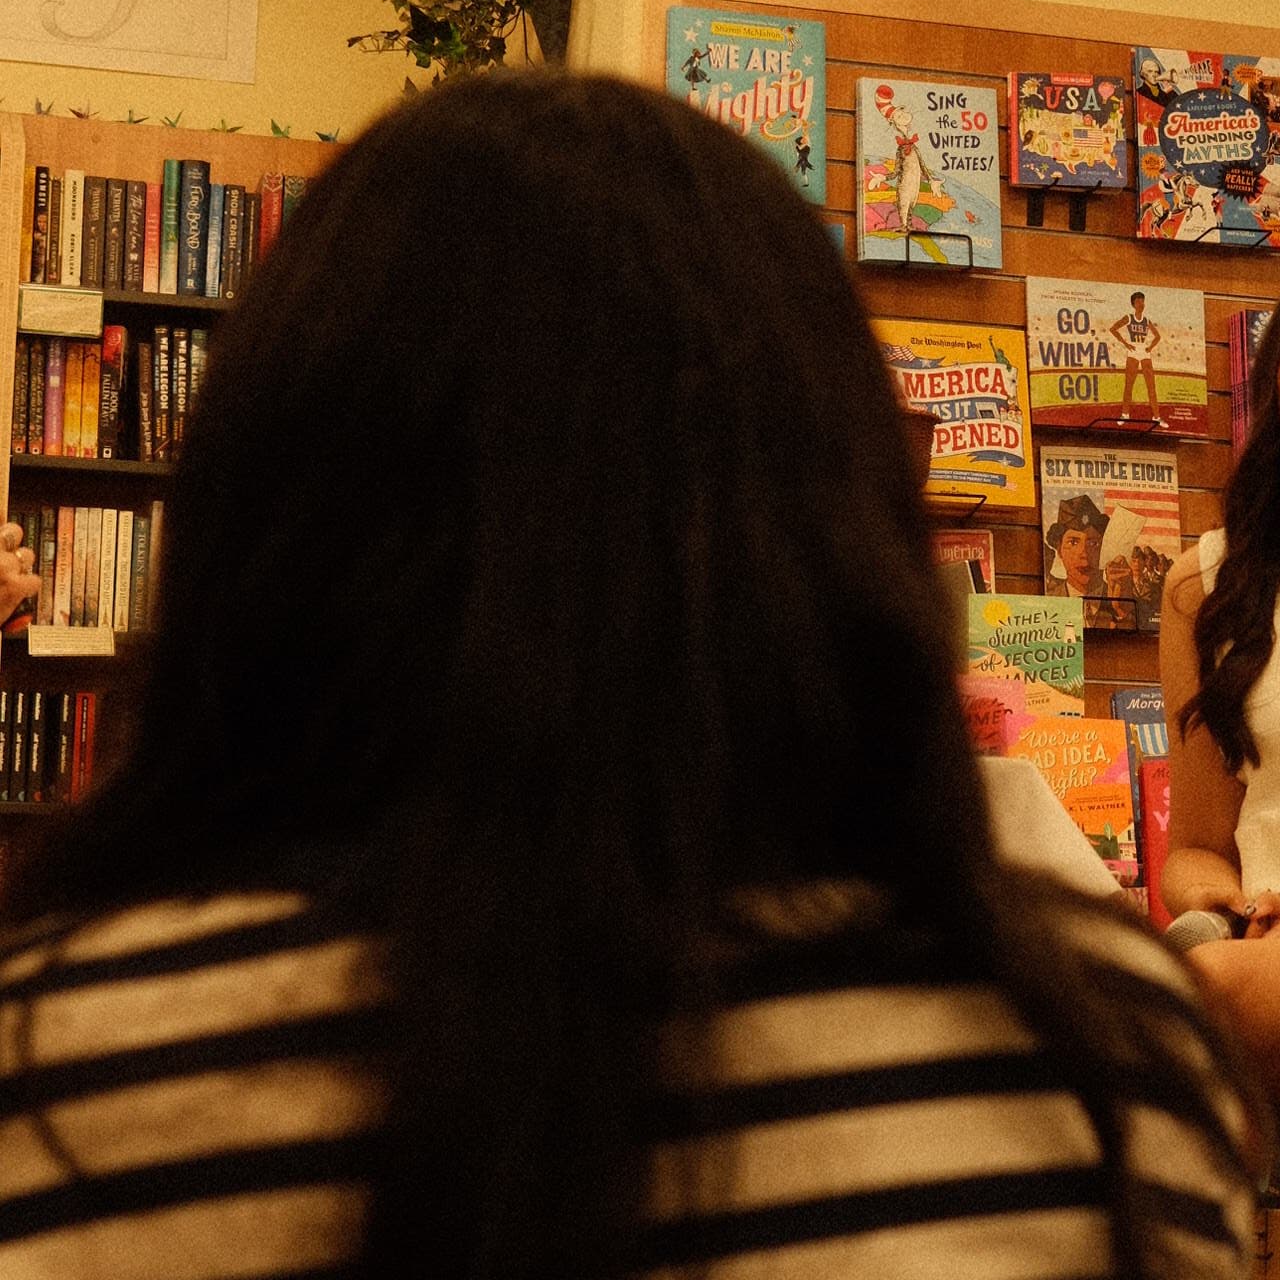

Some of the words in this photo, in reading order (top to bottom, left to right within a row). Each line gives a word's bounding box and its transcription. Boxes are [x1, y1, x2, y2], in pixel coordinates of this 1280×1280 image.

[707, 42, 740, 69] WE
[745, 47, 793, 74] ARE
[686, 69, 814, 140] Mighty
[936, 114, 958, 130] the
[961, 111, 988, 131] 50
[1166, 110, 1259, 136] America's
[1178, 131, 1254, 145] FOUNDING
[1184, 143, 1252, 161] MYTHS
[1225, 173, 1257, 186] REALLY
[230, 189, 239, 216] SNOW
[228, 218, 237, 248] CRASH
[1057, 308, 1096, 336] GO,
[160, 337, 169, 351] WE
[179, 340, 187, 354] WE
[925, 337, 966, 348] Washington
[967, 341, 982, 349] Post
[160, 352, 169, 372] ARE
[178, 355, 186, 375] ARE
[160, 373, 169, 410] LEGION
[177, 376, 186, 412] LEGION
[902, 366, 1009, 399] MERICA
[1058, 374, 1099, 401] GO!
[931, 402, 951, 419] AS
[955, 401, 971, 418] IT
[934, 423, 1019, 454] PENED
[1045, 458, 1072, 477] SIX
[1074, 460, 1128, 480] TRIPLE
[1131, 463, 1174, 483] EIGHT
[137, 533, 146, 573] TOLKIEN
[1014, 613, 1041, 626] THE
[989, 626, 1061, 648] Summer
[973, 654, 1002, 672] of
[1003, 646, 1077, 668] SECOND
[1019, 730, 1080, 748] We're
[1083, 730, 1098, 741] a
[1063, 744, 1111, 766] IDEA,
